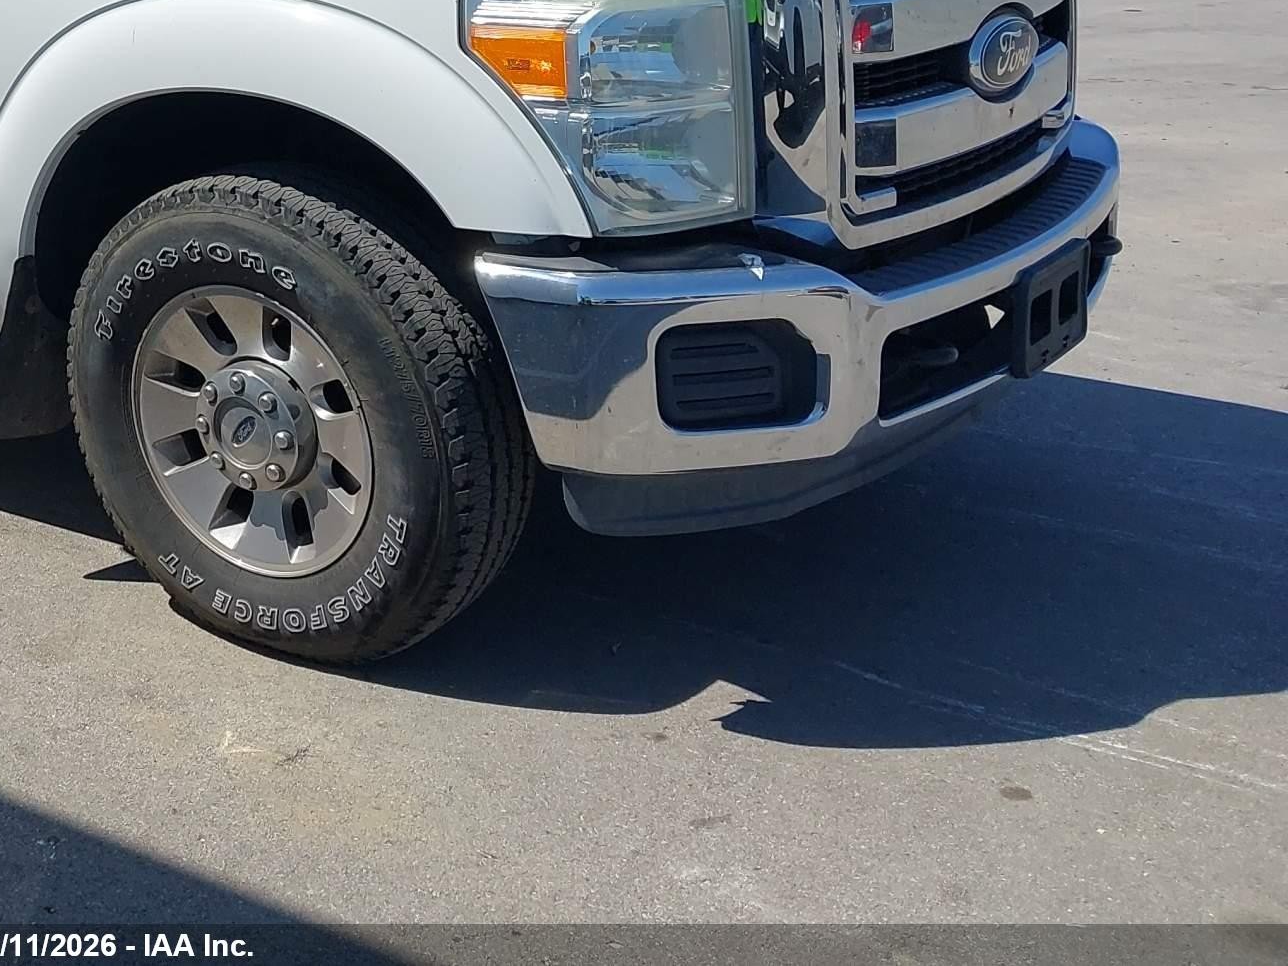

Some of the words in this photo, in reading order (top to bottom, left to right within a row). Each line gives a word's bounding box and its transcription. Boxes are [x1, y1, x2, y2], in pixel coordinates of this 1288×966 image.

[996, 28, 1032, 76] Ford
[94, 238, 297, 341] Firestone
[237, 420, 253, 441] Ford
[158, 553, 205, 590] AT
[212, 514, 408, 633] TRANSFORCE
